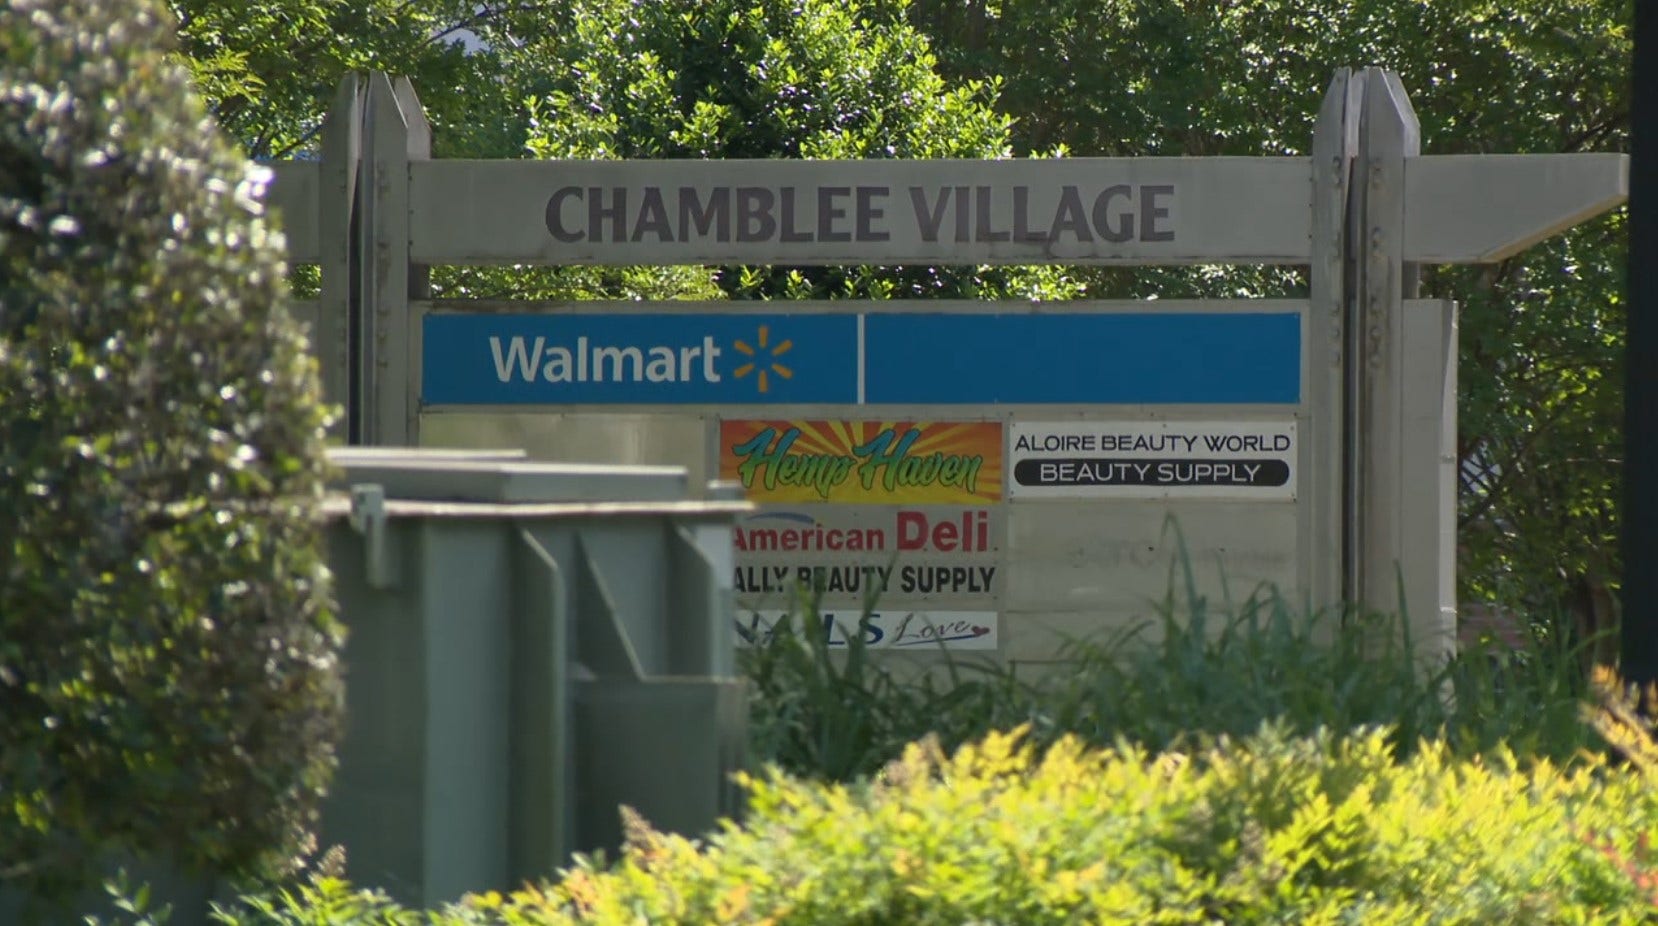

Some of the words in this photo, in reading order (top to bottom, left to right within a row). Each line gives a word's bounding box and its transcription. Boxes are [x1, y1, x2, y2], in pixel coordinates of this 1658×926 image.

[545, 185, 891, 243] CHAMBLEE
[908, 185, 1176, 242] VILLAGE
[489, 335, 721, 384] Walmart
[732, 426, 856, 499] Hemp
[852, 427, 983, 494] Haven
[1014, 435, 1096, 451] ALOIRE
[1101, 435, 1198, 451] BEAUTY
[1203, 434, 1291, 452] WORLD
[1040, 463, 1151, 483] BEAUTY
[1157, 463, 1261, 483] SUPPLY
[897, 511, 988, 552] Deli
[733, 566, 789, 593] ALLY
[797, 566, 893, 593] BEAUTY
[901, 566, 996, 593] SUPPLY
